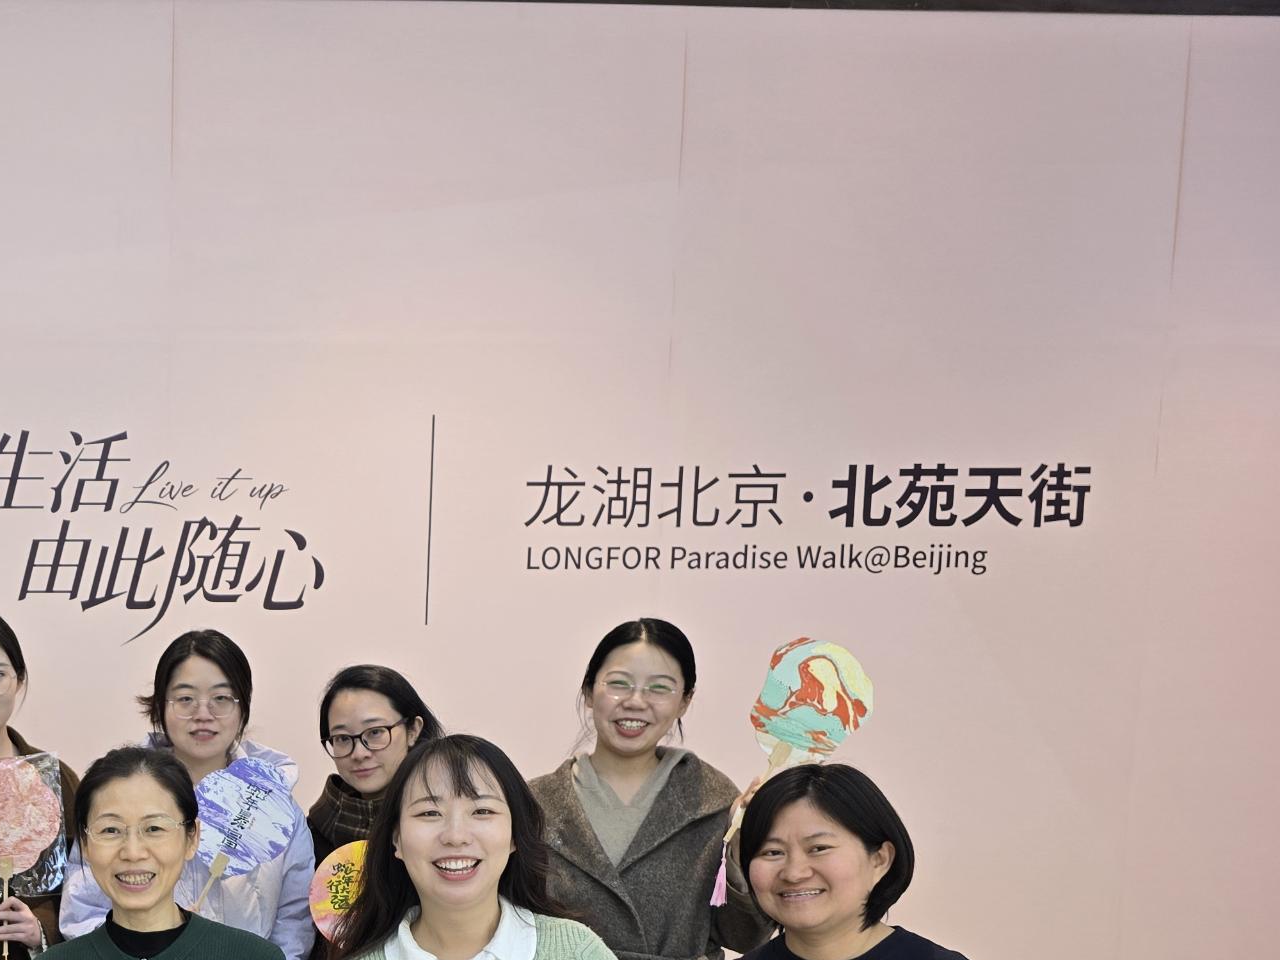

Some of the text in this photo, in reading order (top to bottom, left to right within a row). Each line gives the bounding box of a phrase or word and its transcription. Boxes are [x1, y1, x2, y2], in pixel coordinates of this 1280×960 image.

[120, 461, 289, 514] Live it up
[18, 514, 325, 646] 由此随心
[525, 543, 988, 576] LONGFOR Paradise Walk@Beijing
